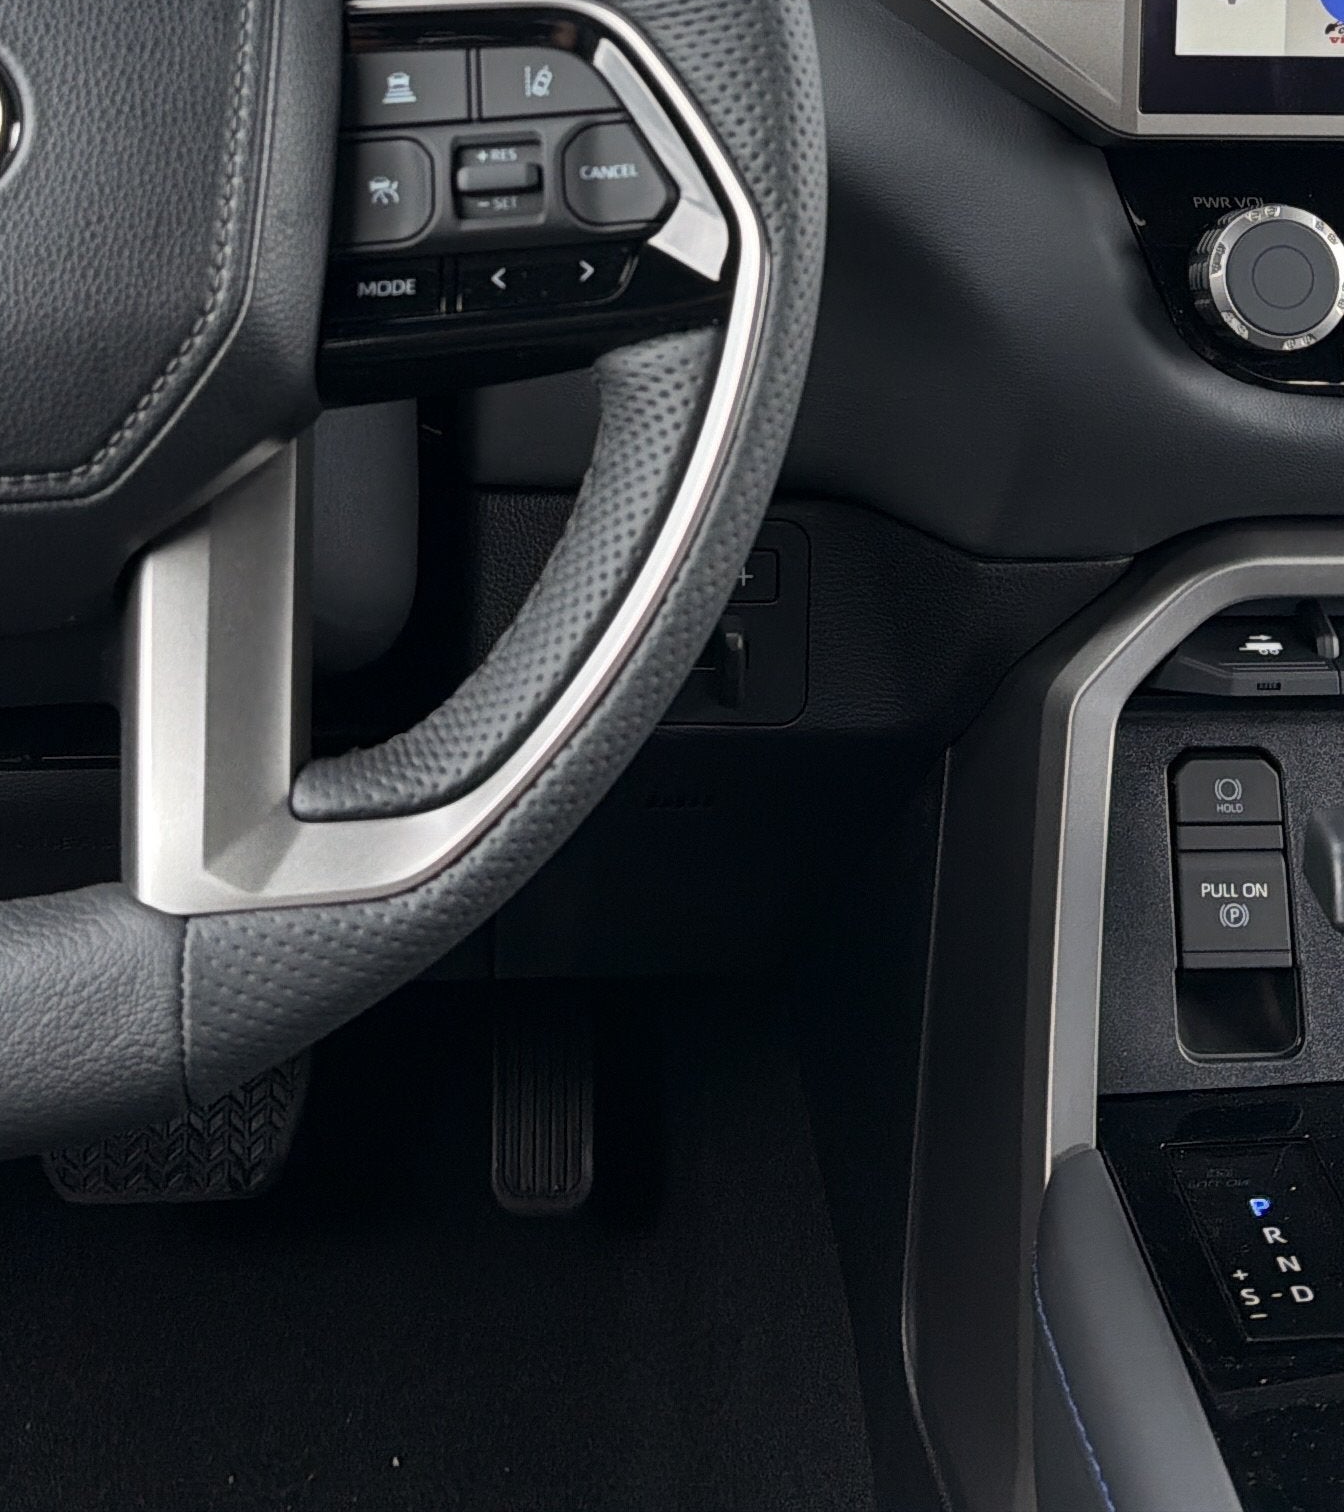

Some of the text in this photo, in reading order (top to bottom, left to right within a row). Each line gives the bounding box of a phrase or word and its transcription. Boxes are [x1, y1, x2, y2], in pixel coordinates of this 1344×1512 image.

[579, 164, 638, 180] CANCEL
[1193, 196, 1232, 209] PWR
[356, 278, 417, 298] MODE
[1216, 803, 1244, 814] HOLD
[1201, 882, 1269, 899] PULL ON
[1248, 1197, 1271, 1218] P
[1262, 1226, 1288, 1245] R
[1277, 1255, 1303, 1273] N
[1239, 1285, 1316, 1306] S D
